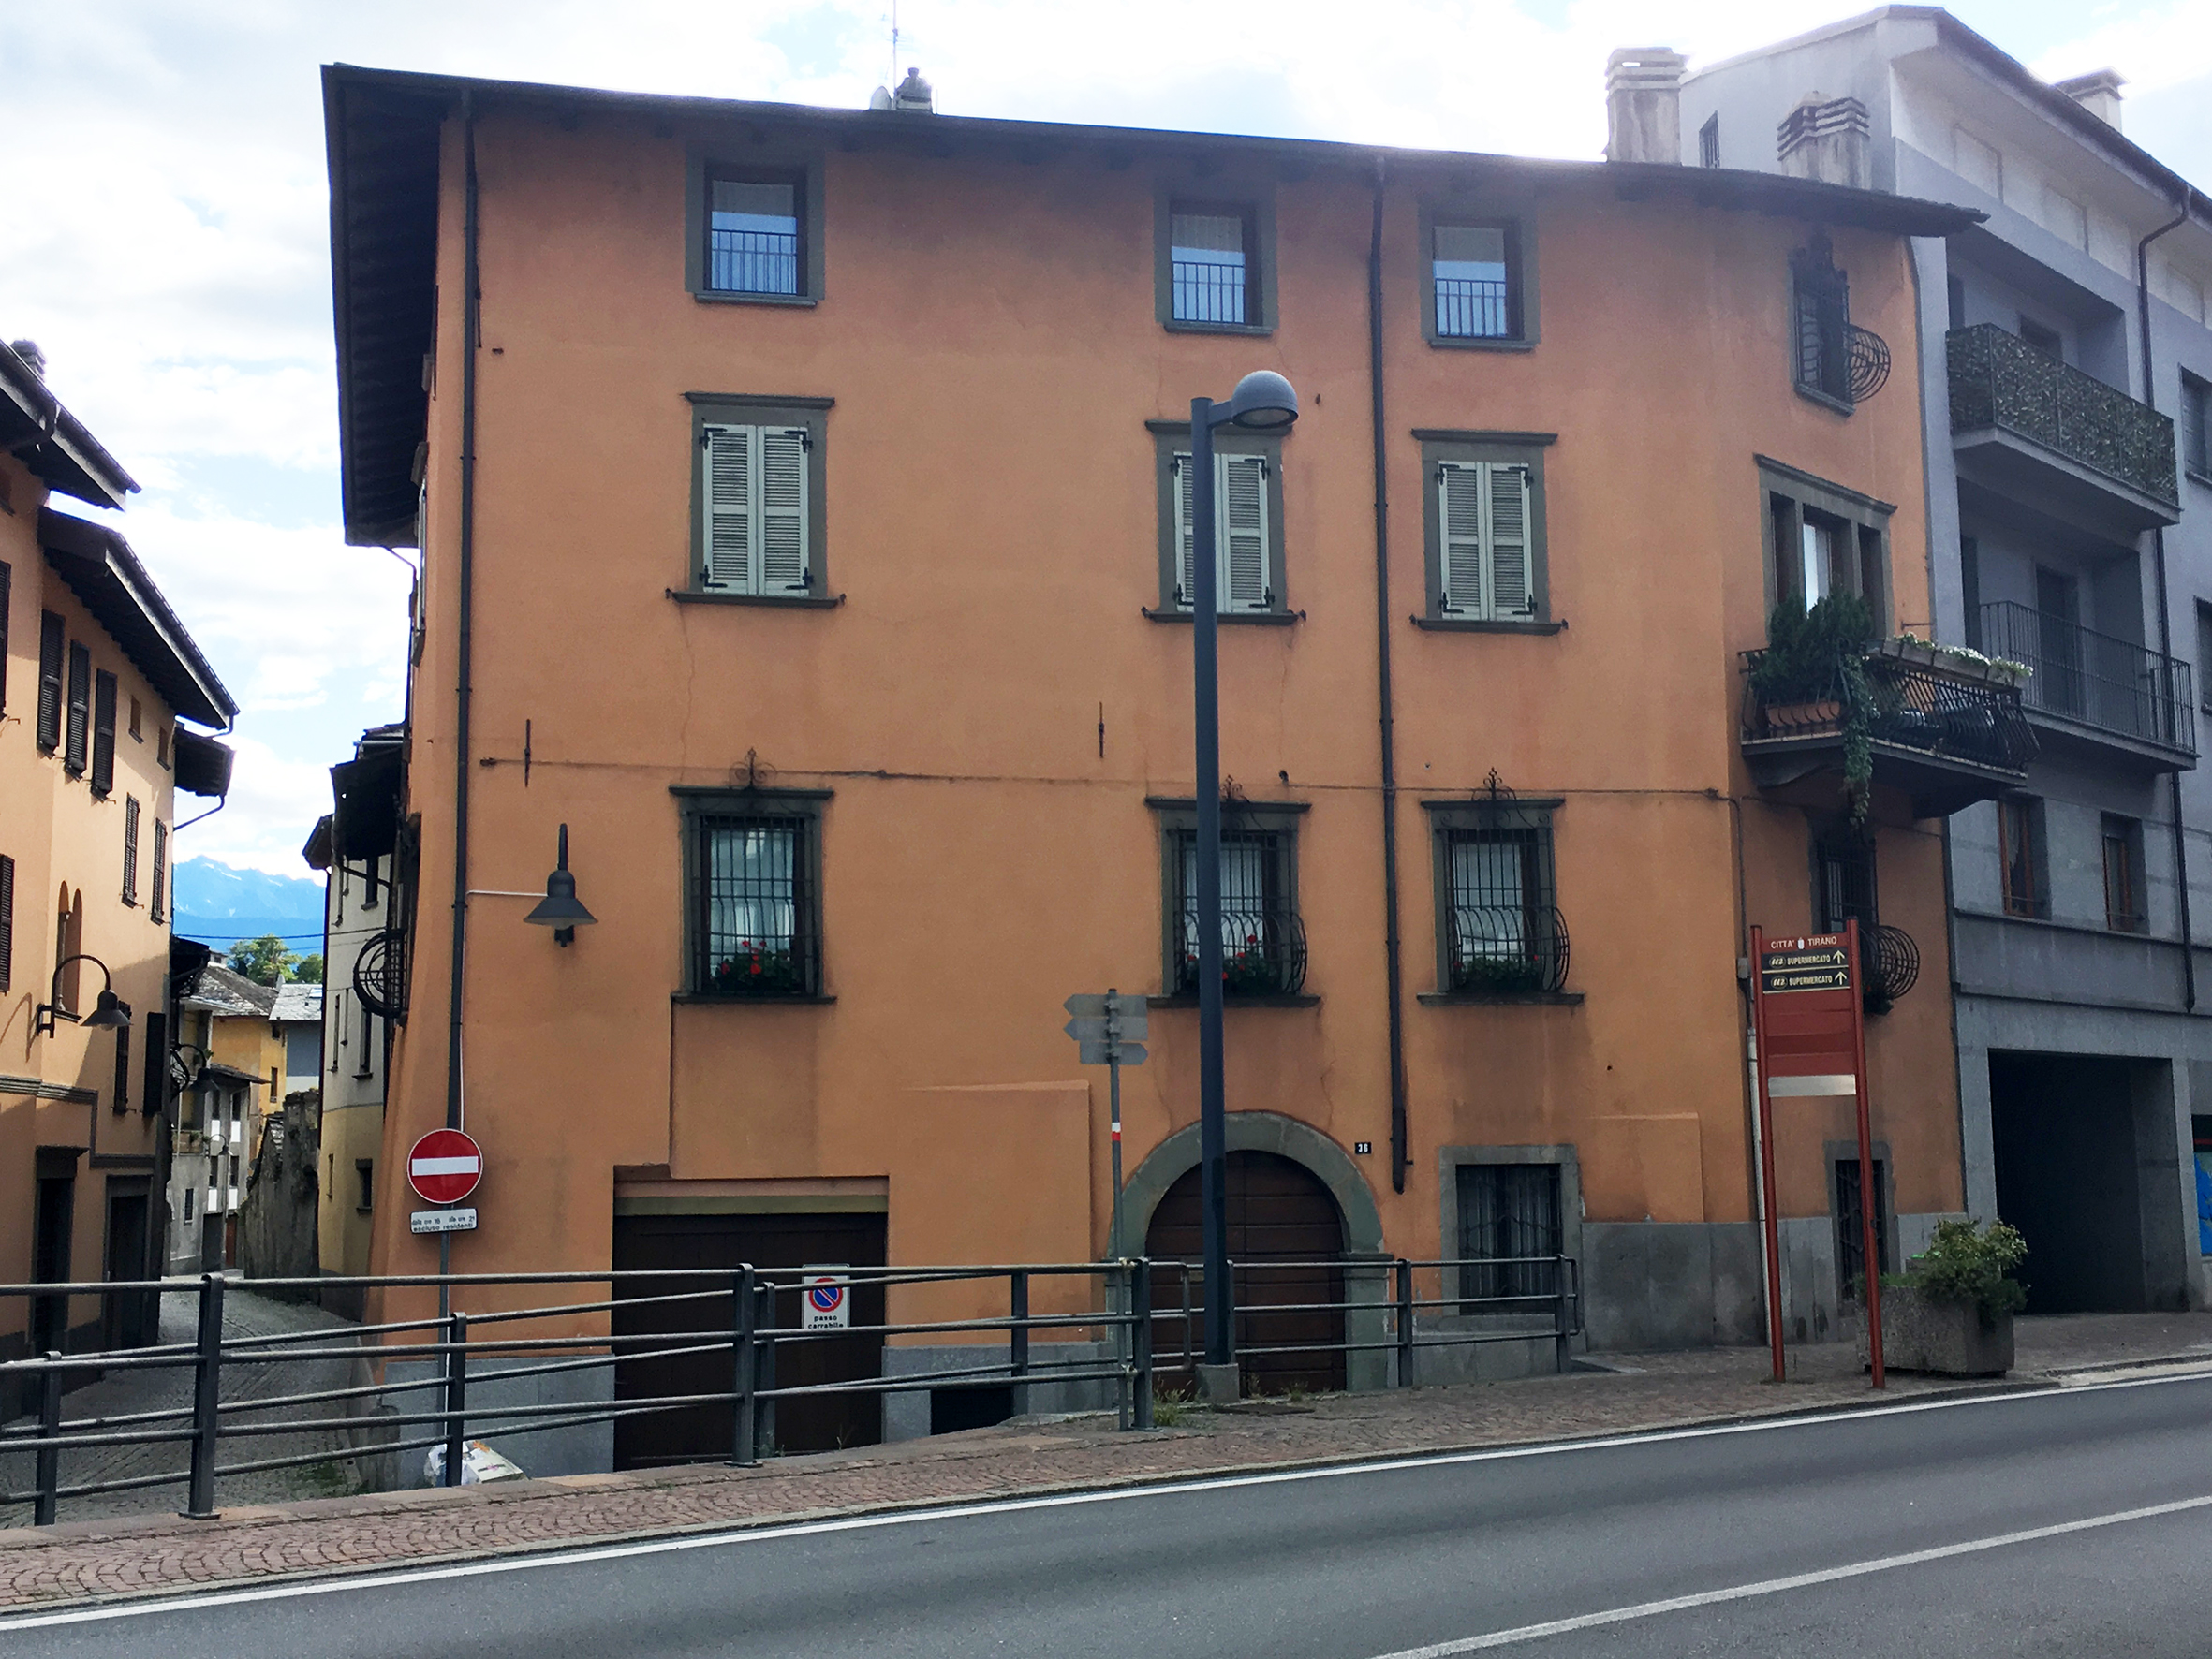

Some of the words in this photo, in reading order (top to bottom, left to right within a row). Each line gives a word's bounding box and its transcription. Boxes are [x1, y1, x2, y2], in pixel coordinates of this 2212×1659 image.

[1807, 936, 1837, 947] TIRANO
[1787, 954, 1831, 965] SUPERMERCATO
[1789, 975, 1833, 986] SUPERMERCATO
[443, 1222, 473, 1230] residenti
